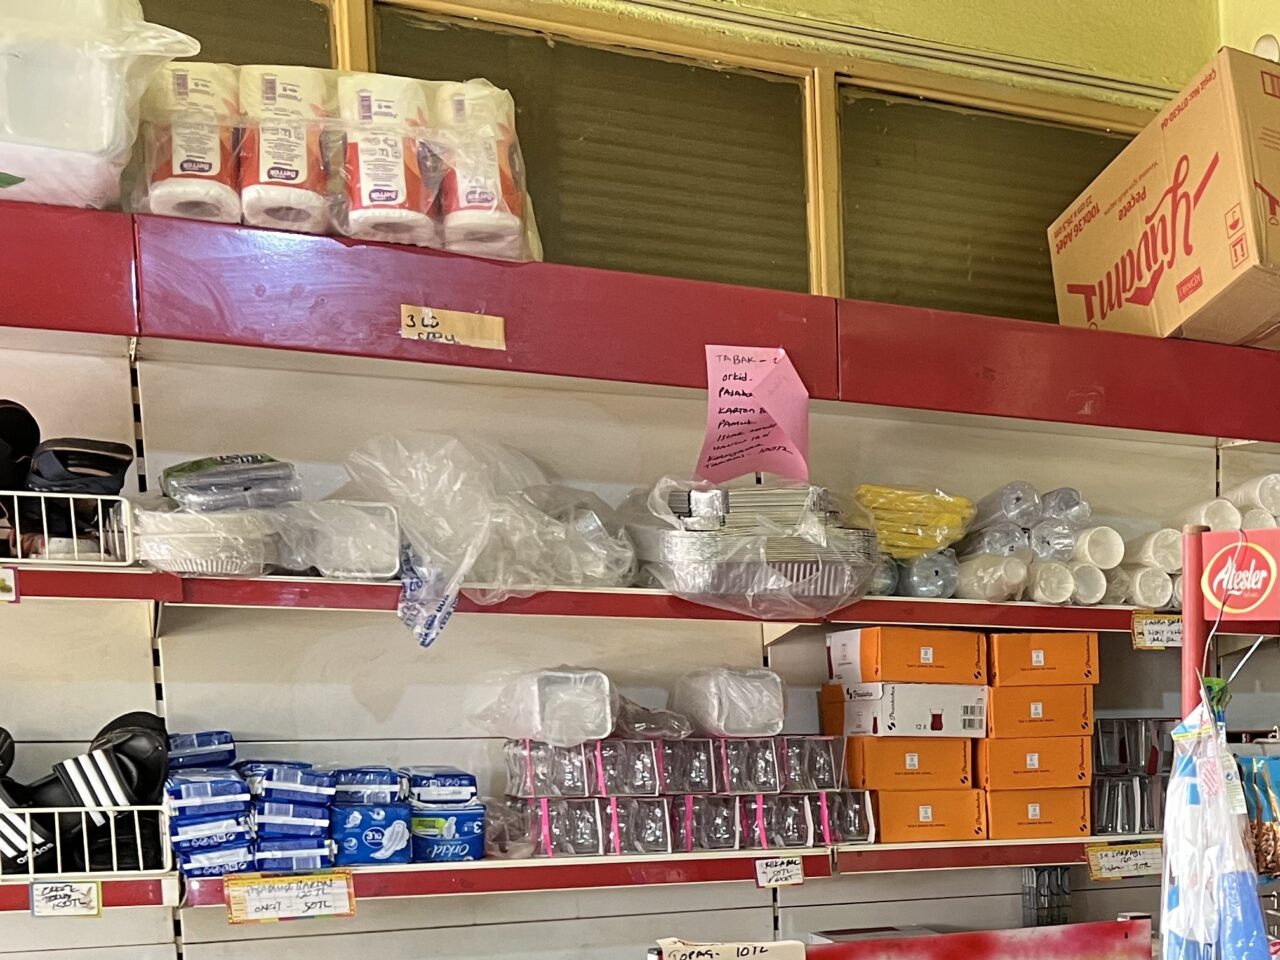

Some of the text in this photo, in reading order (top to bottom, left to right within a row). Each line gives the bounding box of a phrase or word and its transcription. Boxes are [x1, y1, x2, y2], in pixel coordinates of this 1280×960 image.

[1212, 556, 1269, 597] Atesler
[15, 841, 55, 866] adidas
[430, 843, 471, 859] Orkid
